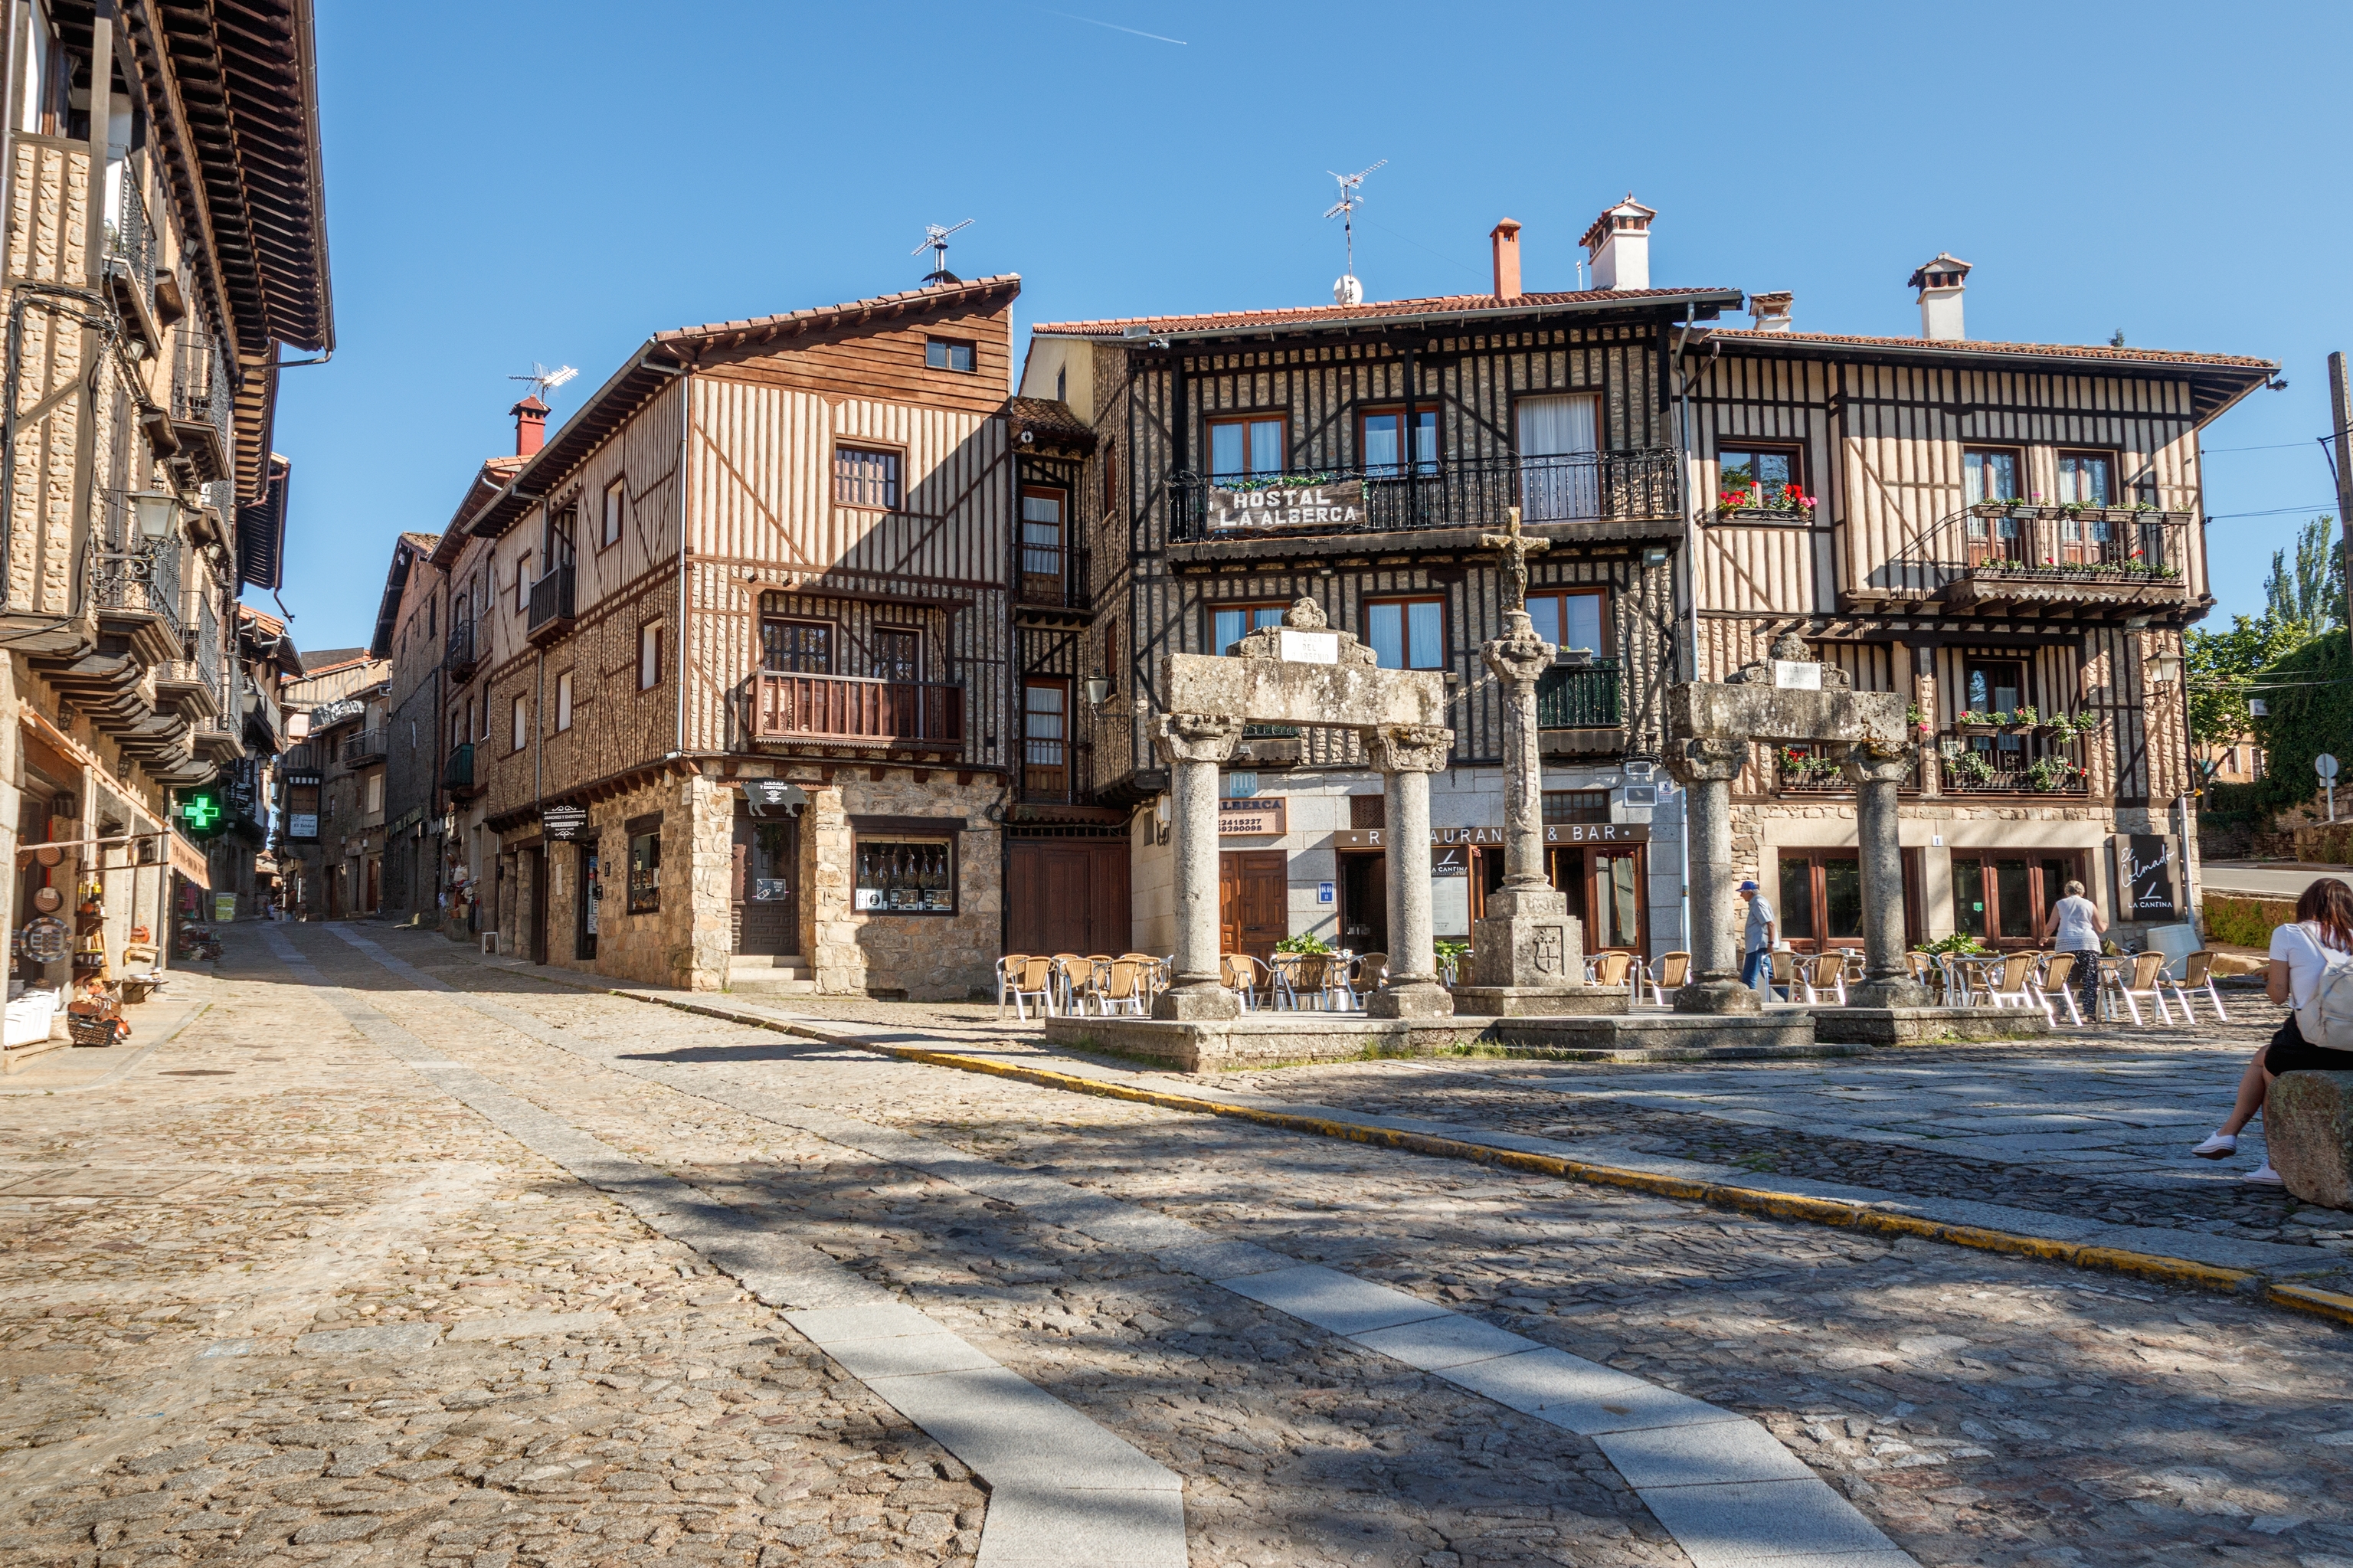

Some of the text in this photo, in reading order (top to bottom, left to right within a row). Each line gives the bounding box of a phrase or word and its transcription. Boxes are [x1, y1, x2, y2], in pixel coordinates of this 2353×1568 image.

[1234, 489, 1331, 509] HOSTAL
[1220, 506, 1356, 526] LA ALBERCA
[1297, 633, 1322, 643] PLAZA
[1302, 643, 1317, 651] DEL
[1232, 774, 1255, 788] HR
[1219, 800, 1281, 810] LBERCA
[1547, 827, 1558, 841] &
[1573, 826, 1615, 841] BAR
[2120, 847, 2135, 863] El
[2121, 843, 2175, 887] Colmado
[1321, 885, 1332, 893] RB
